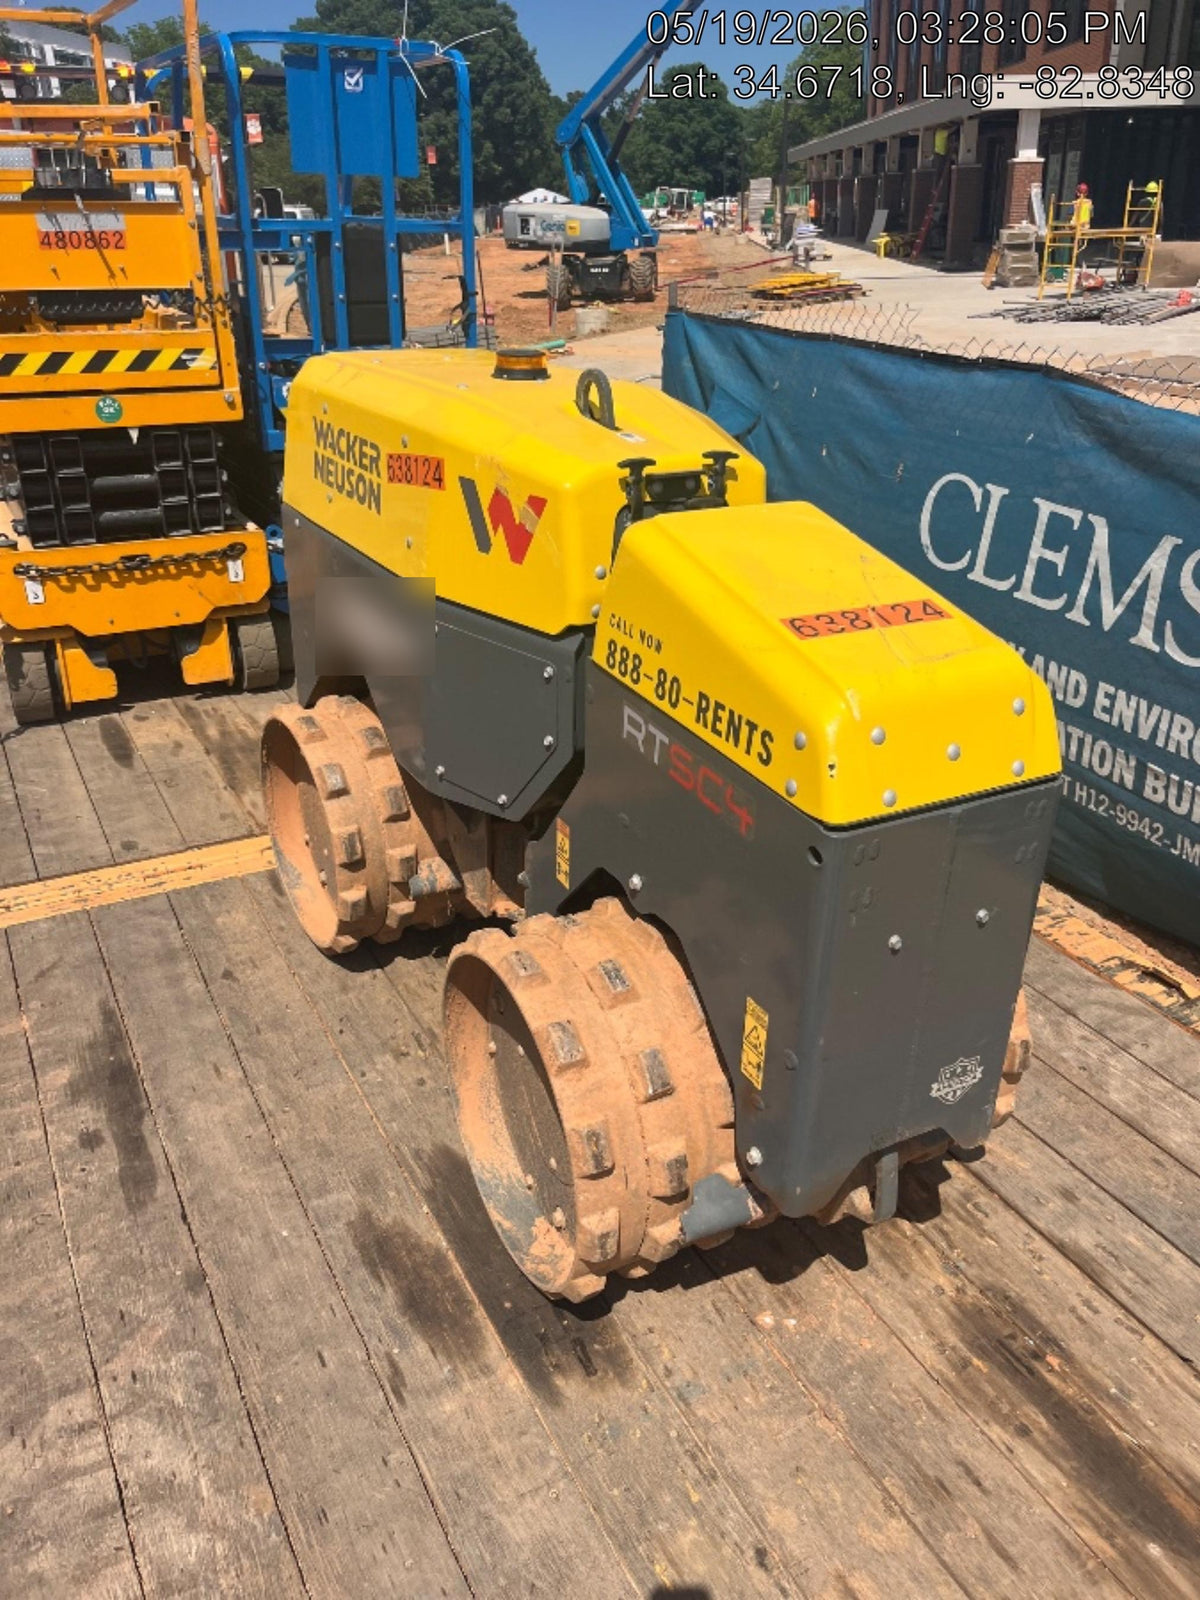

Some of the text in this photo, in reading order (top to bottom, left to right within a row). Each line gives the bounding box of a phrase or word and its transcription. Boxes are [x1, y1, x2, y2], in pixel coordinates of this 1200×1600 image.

[40, 230, 125, 250] 480862
[312, 415, 381, 479] WACKER
[387, 454, 443, 488] 638124
[313, 450, 381, 516] NEUSON
[609, 613, 664, 654] CALL NOW
[789, 600, 944, 638] 638124
[606, 638, 774, 767] 888-80-RENTS
[1031, 653, 1088, 709] AND
